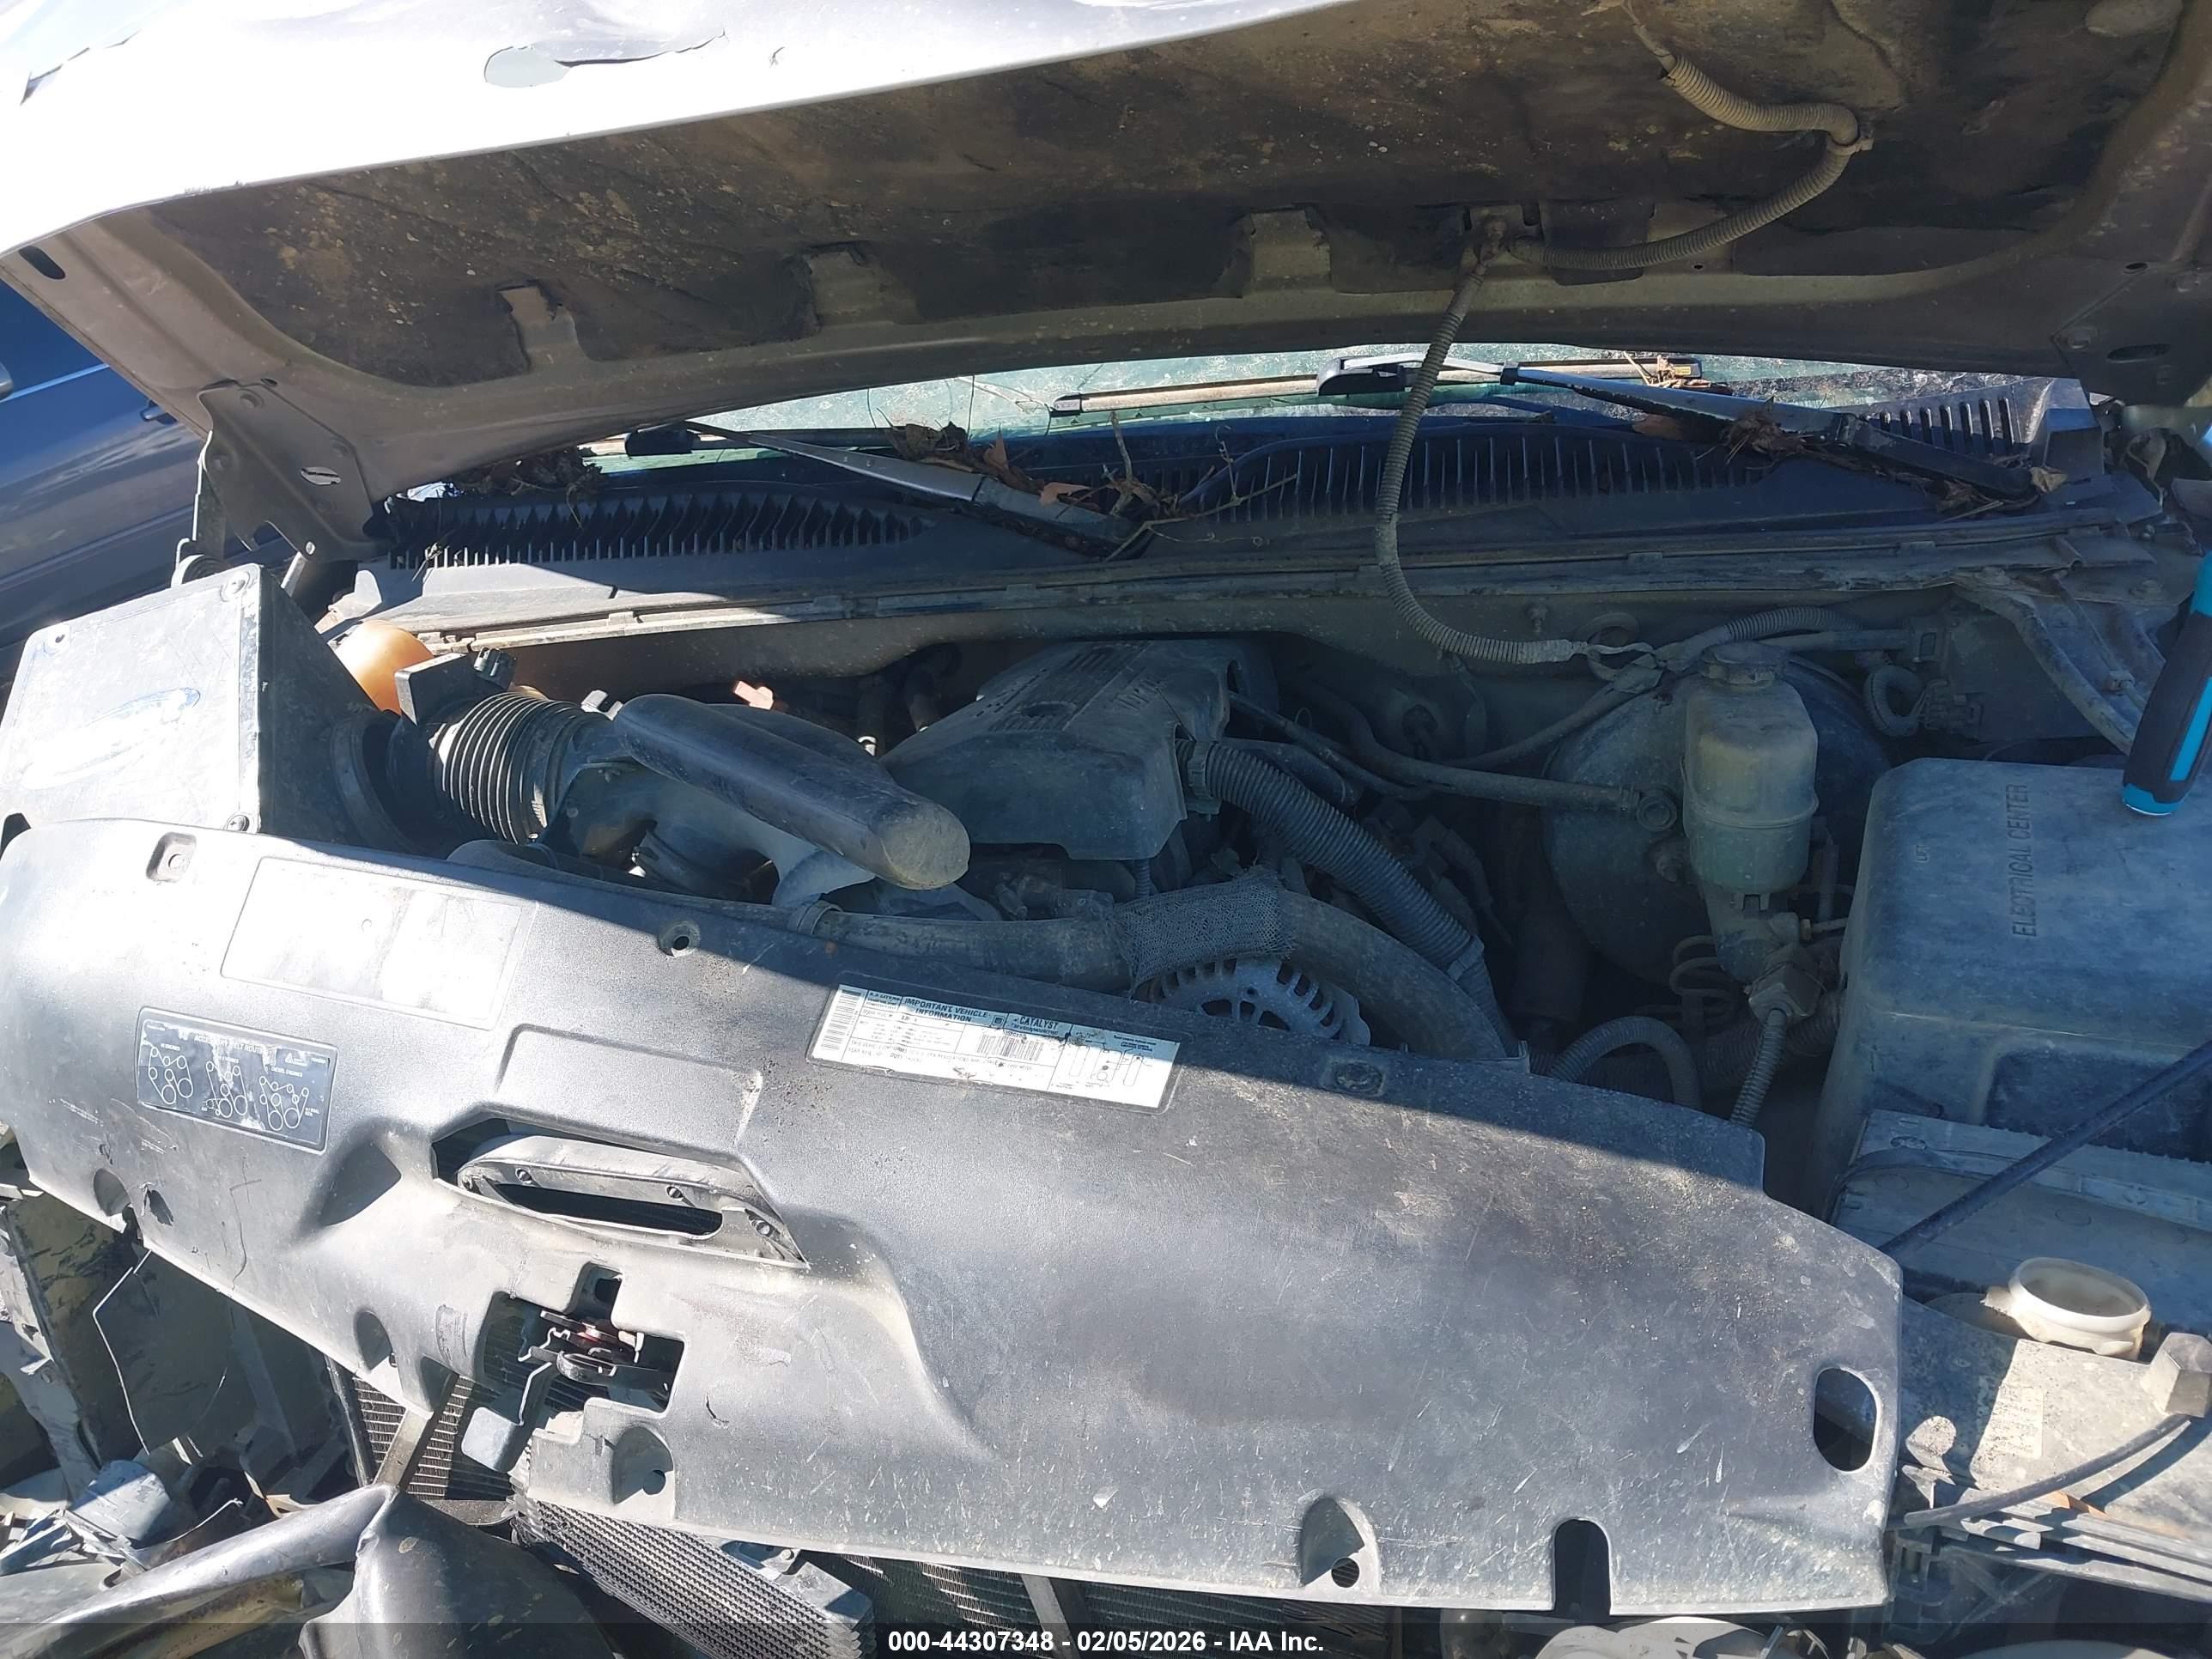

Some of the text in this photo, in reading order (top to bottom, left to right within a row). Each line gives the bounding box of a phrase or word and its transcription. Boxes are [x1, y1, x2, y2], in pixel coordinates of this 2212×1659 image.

[2005, 783, 2037, 937] ELECTRICAL CENTER
[904, 998, 953, 1012] IMPORTANT
[954, 1006, 988, 1018] VEHICLE
[915, 1007, 972, 1023] INFORMATION
[1019, 1016, 1059, 1030] CATALYST
